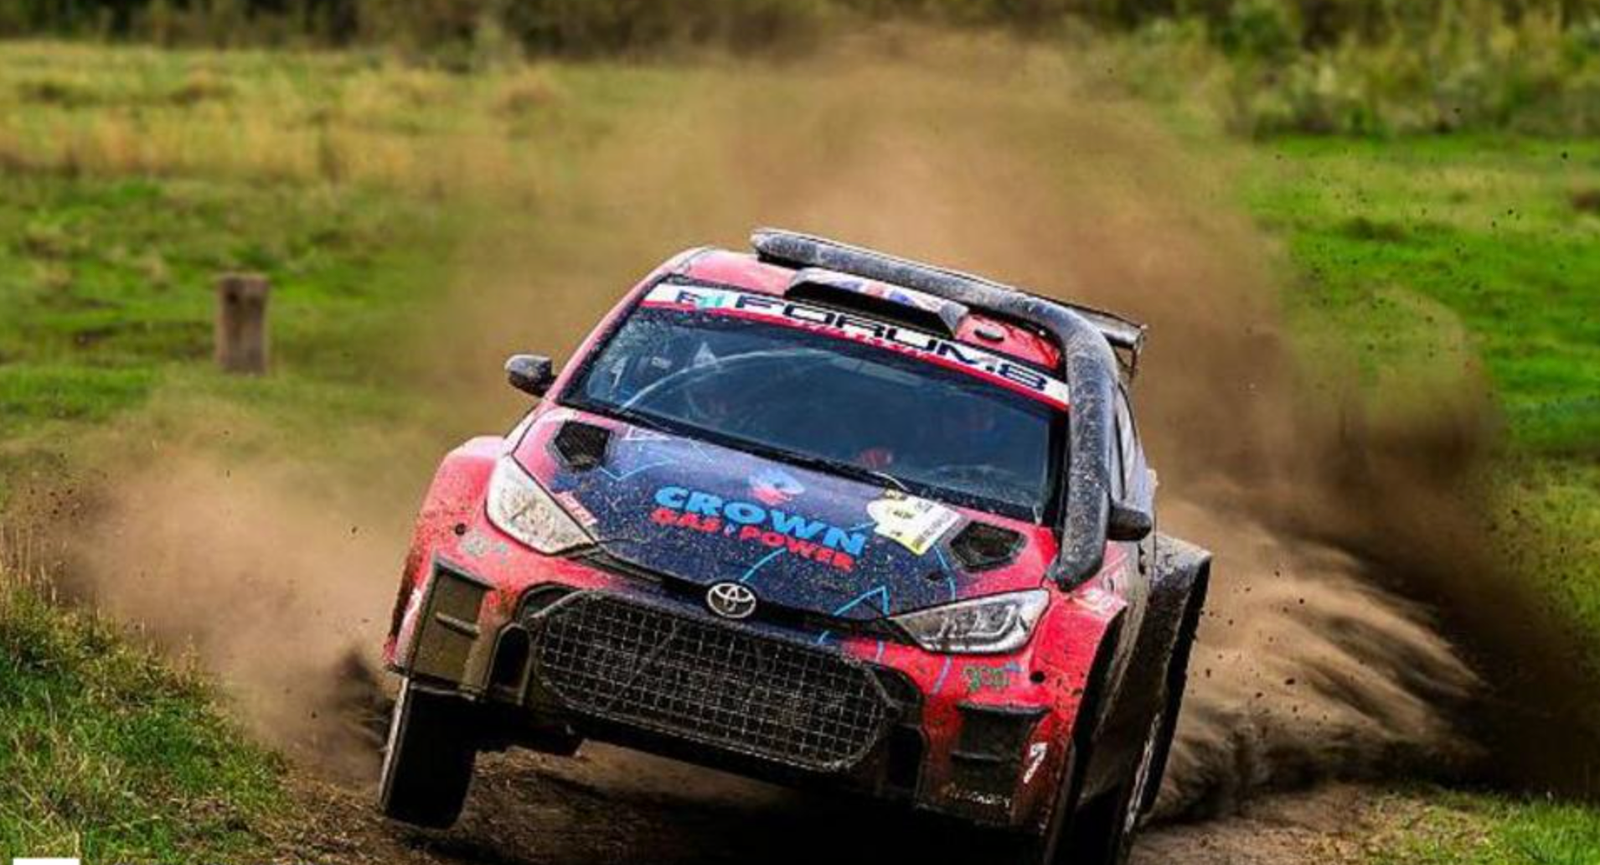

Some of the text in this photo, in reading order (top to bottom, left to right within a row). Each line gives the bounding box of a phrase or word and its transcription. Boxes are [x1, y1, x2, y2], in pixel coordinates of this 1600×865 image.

[652, 508, 721, 533] GAS
[740, 526, 855, 571] POWER
[655, 487, 867, 556] CROWN
